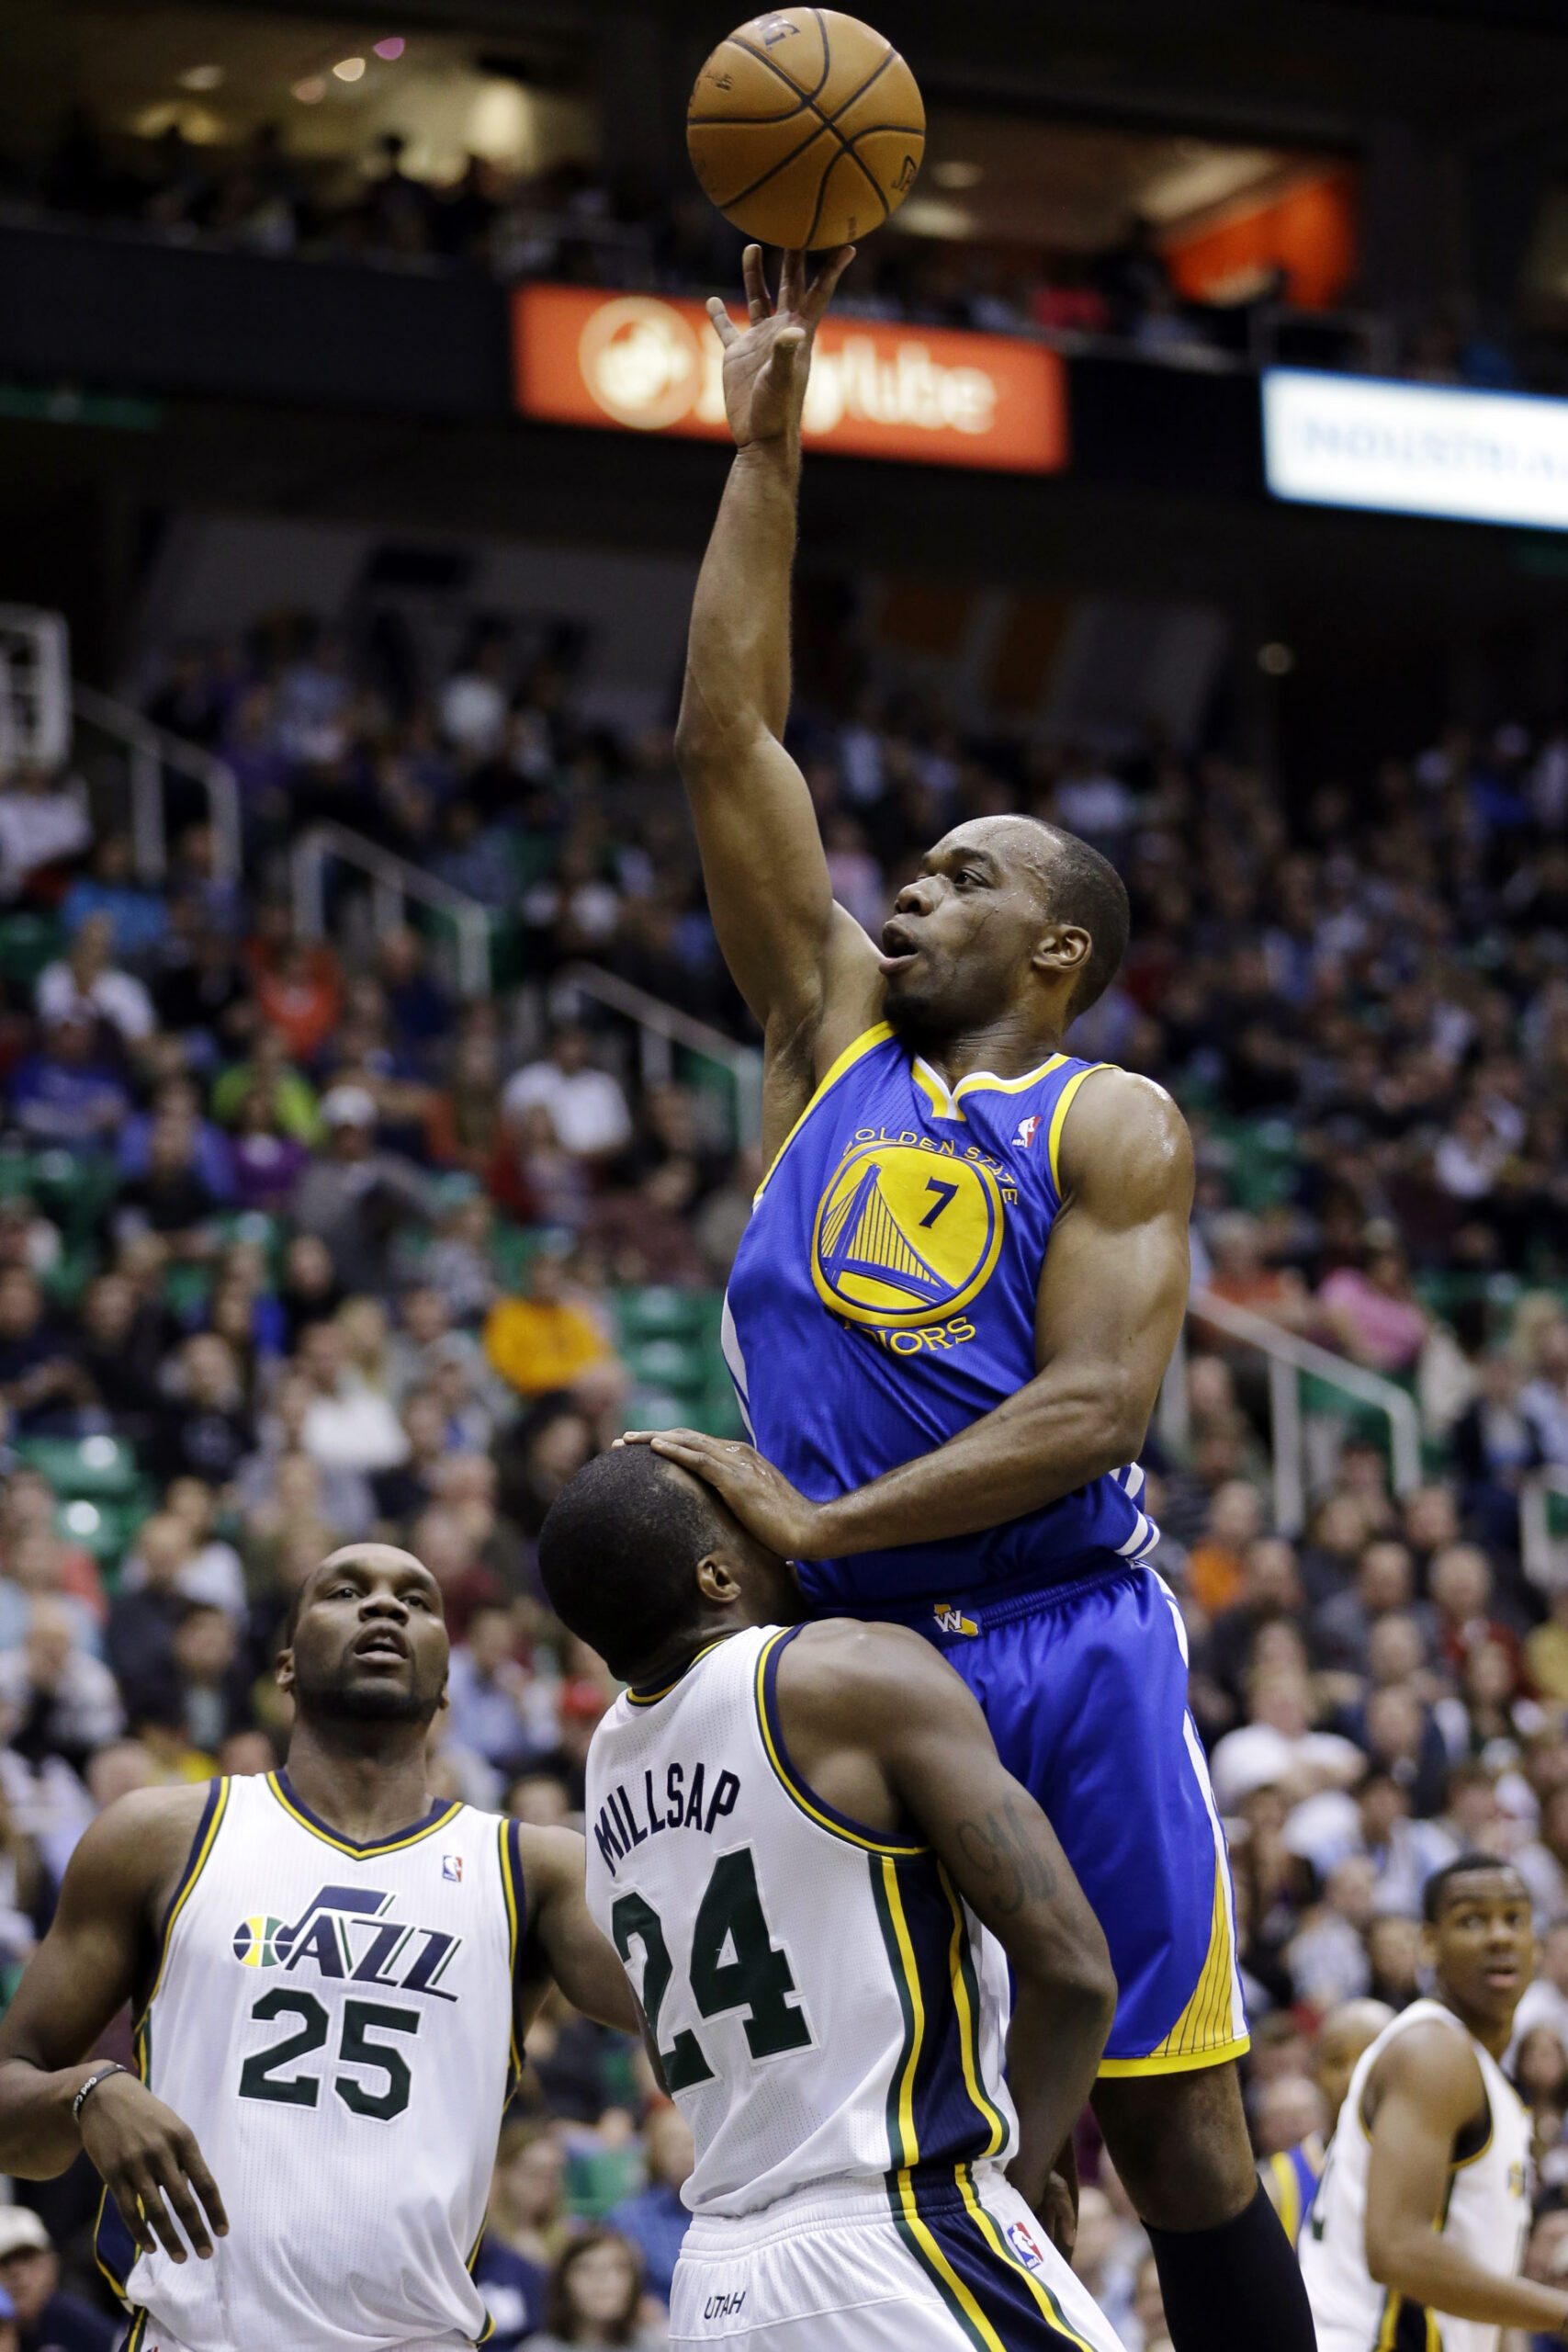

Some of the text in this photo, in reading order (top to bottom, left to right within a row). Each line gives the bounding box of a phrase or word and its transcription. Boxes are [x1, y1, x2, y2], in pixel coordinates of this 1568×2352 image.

[843, 1127, 1019, 1205] OLDEN STATE
[918, 1176, 960, 1229] 7
[932, 1610, 963, 1633] W
[593, 1761, 741, 1878] MILLSAP
[610, 1844, 817, 2096] 24
[237, 1986, 423, 2121] 25
[703, 2290, 746, 2320] UTAH
